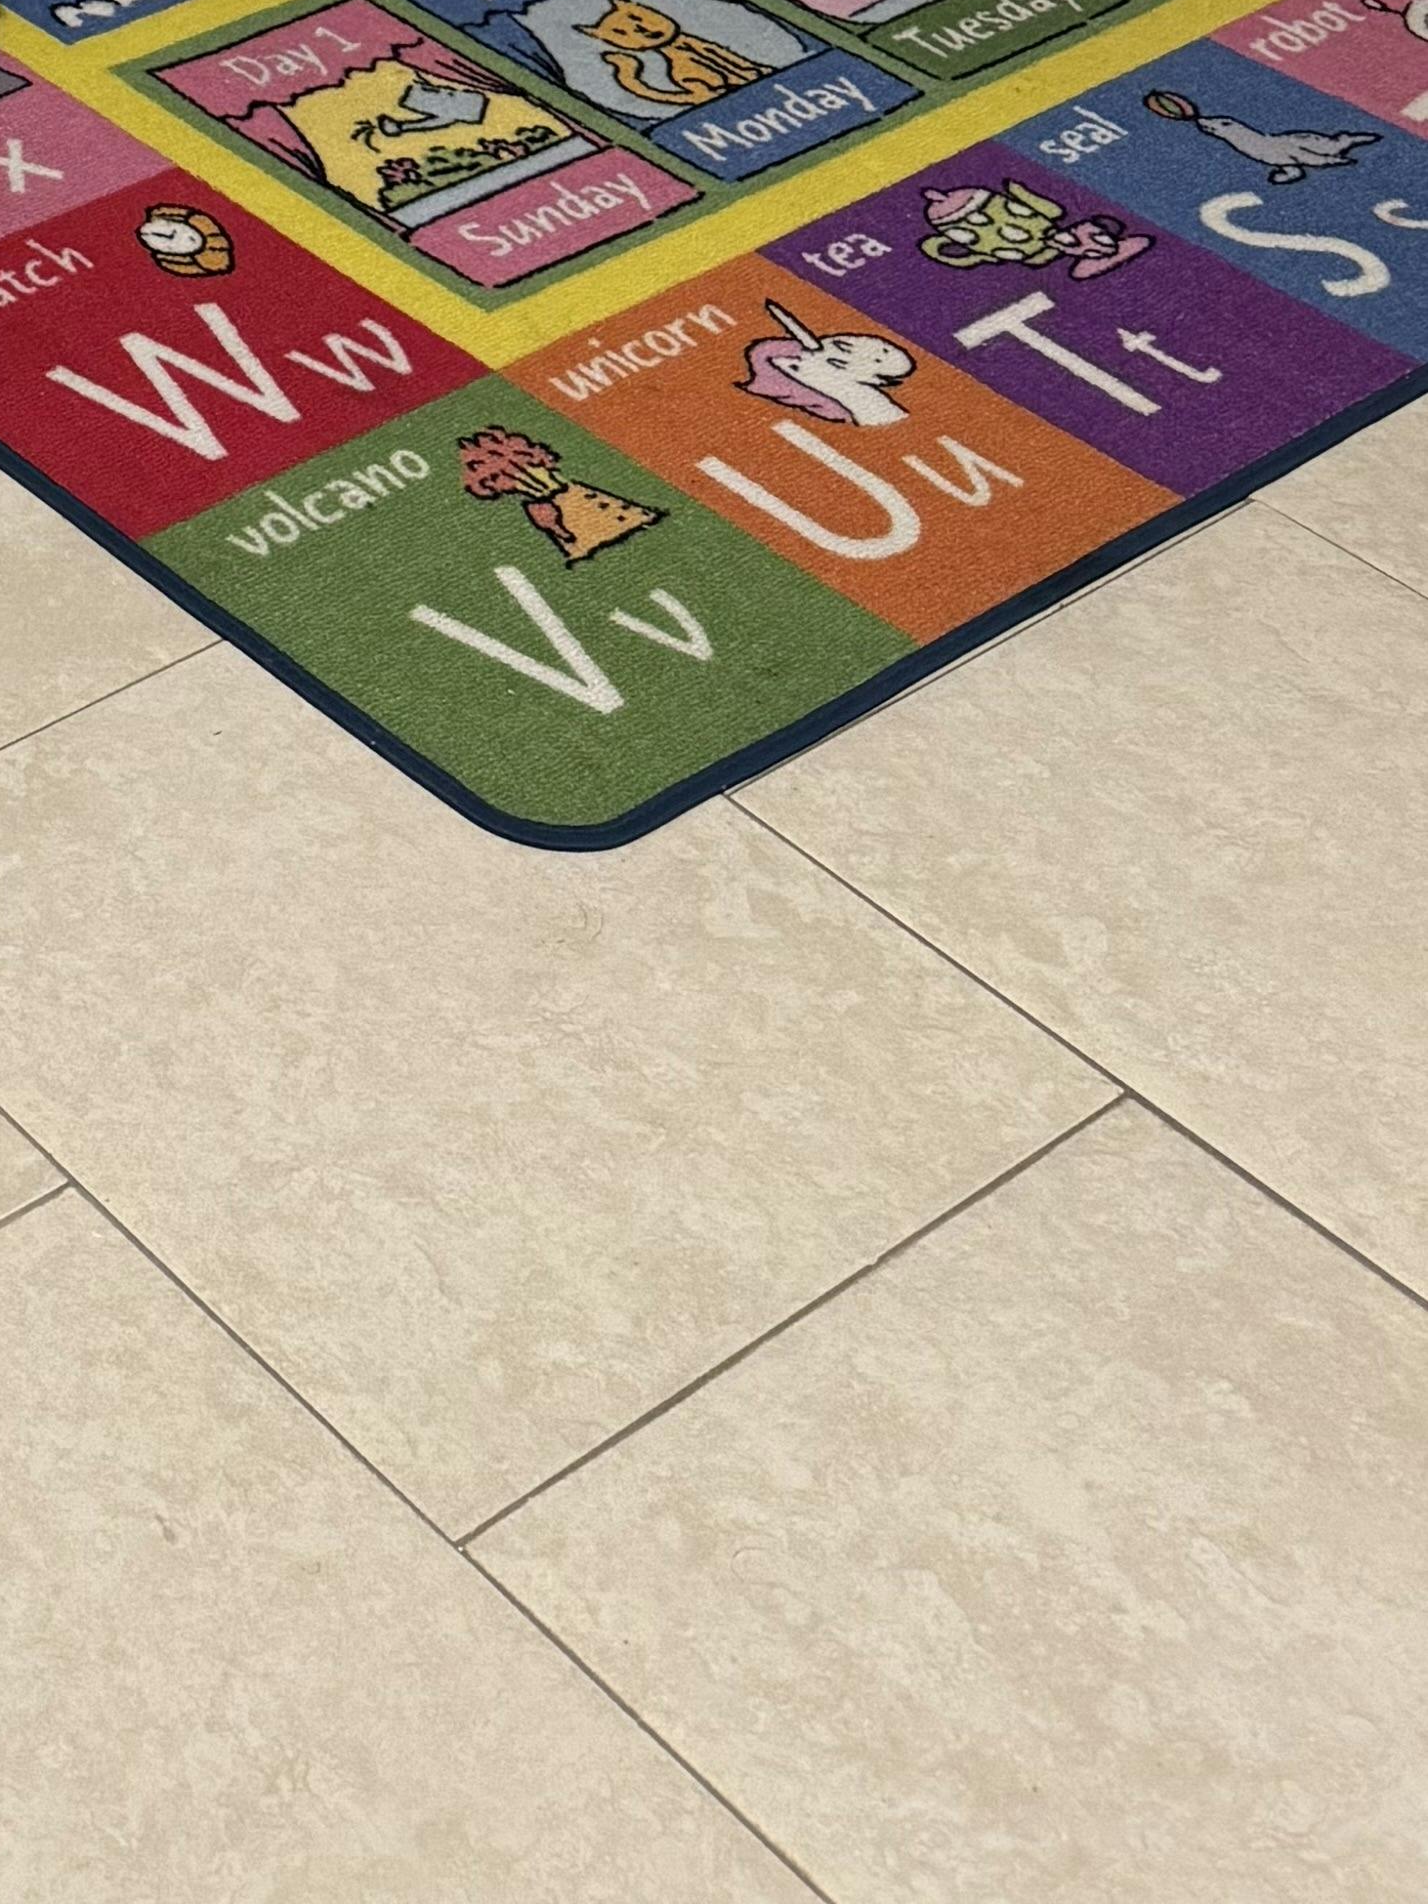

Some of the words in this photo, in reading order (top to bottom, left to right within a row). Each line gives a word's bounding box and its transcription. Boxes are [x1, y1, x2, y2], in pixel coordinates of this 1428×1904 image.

[220, 42, 329, 86] Day
[314, 27, 361, 53] 1
[681, 74, 877, 161] Monday
[1037, 109, 1129, 168] seal
[457, 167, 652, 260] Sunday
[801, 228, 894, 281] tea
[548, 301, 738, 404] unicorn
[225, 445, 431, 558] volcano
